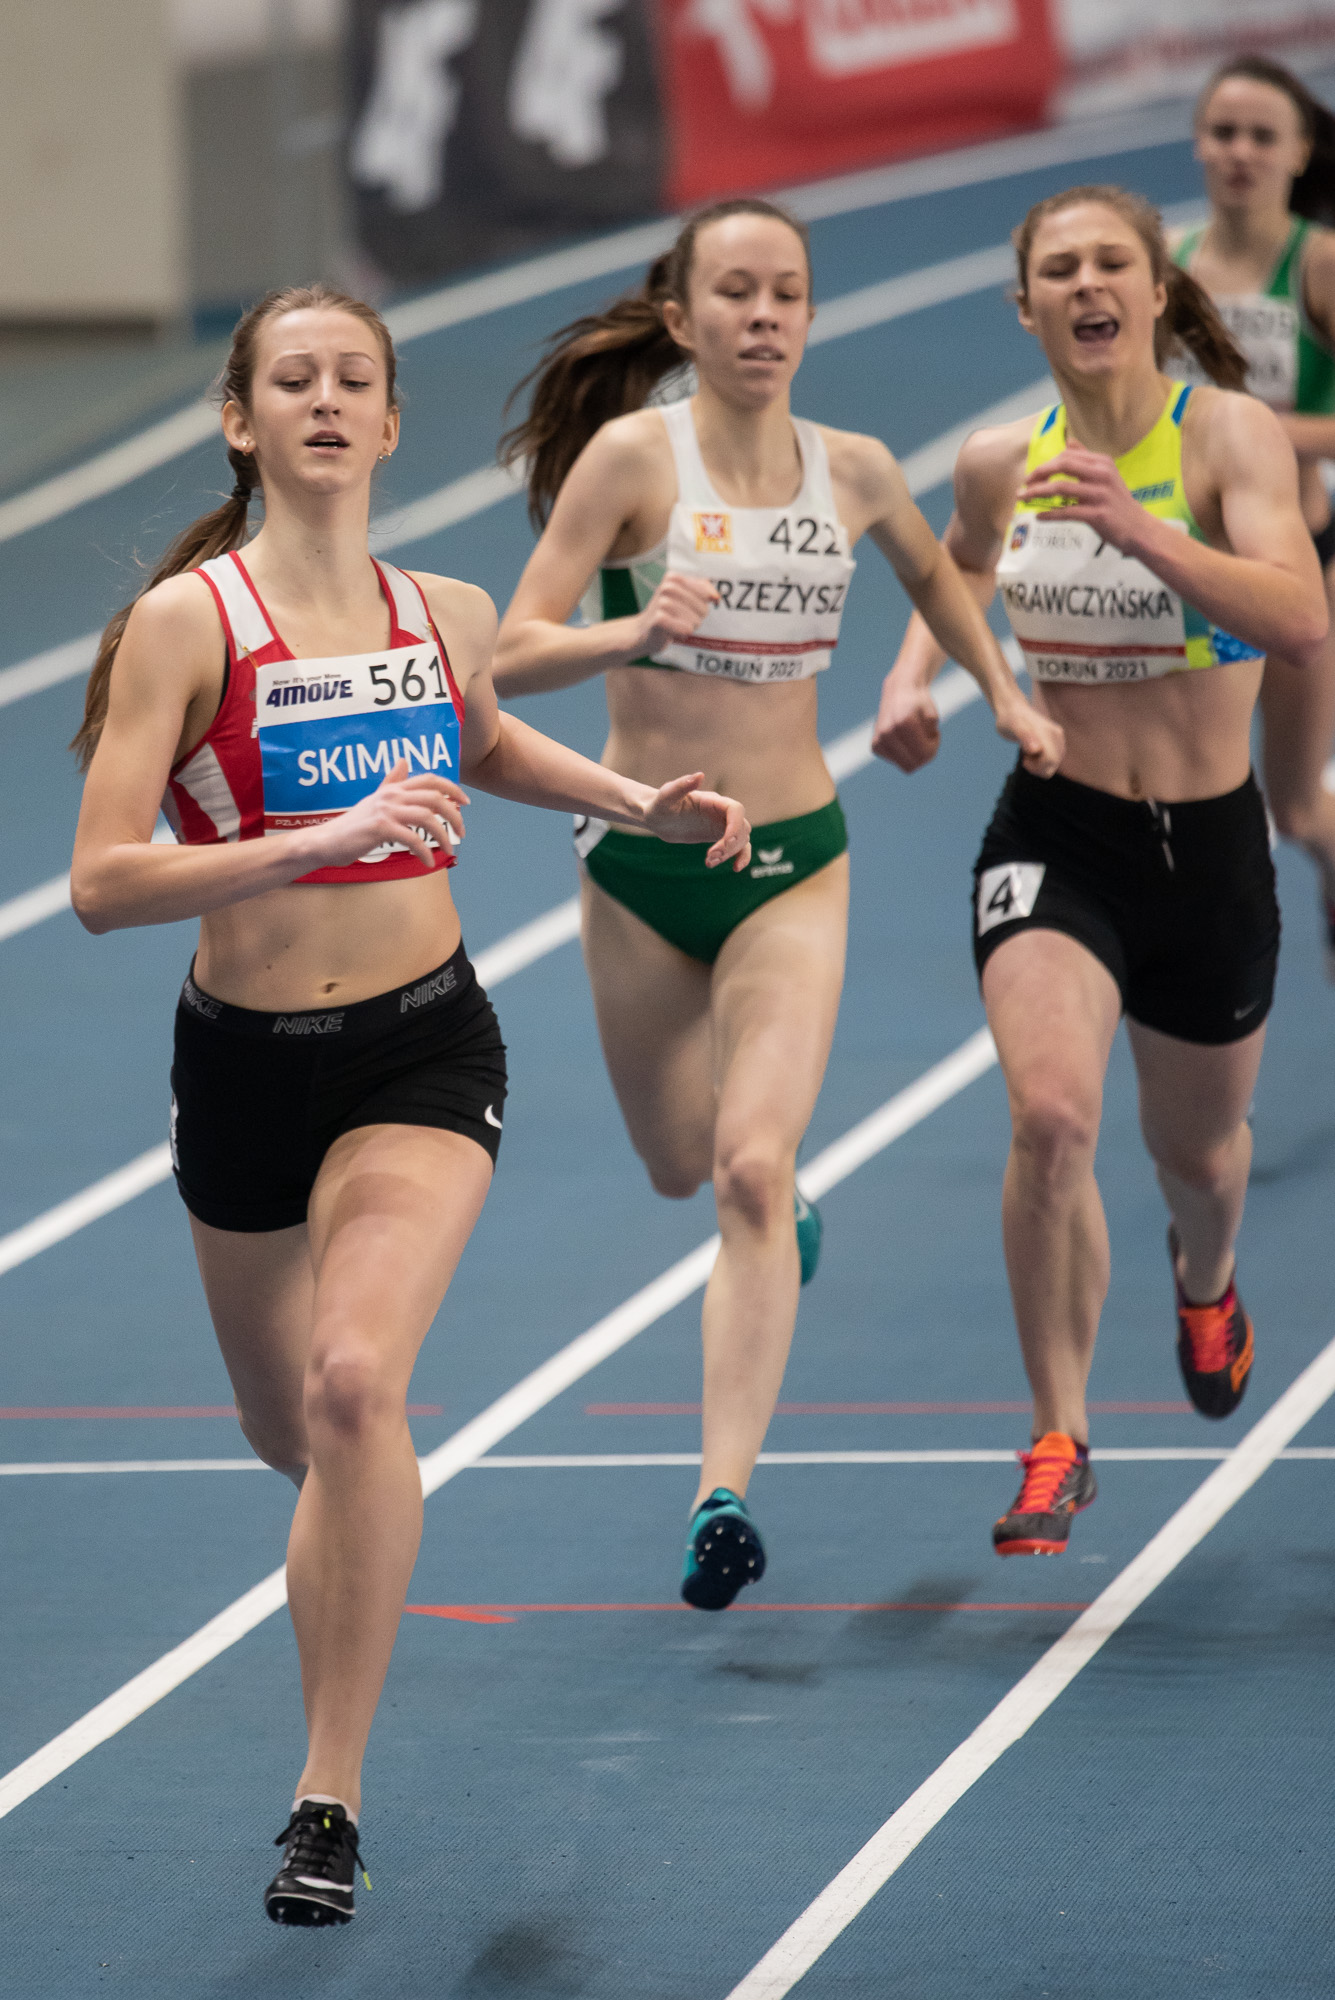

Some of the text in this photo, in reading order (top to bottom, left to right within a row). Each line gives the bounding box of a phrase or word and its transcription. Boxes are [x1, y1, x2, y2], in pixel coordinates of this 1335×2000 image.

[711, 576, 845, 615] RZEŻYSZ
[368, 655, 447, 706] 561
[1104, 660, 1149, 679] 2021
[297, 733, 452, 786] SKIMINA
[986, 874, 1014, 916] 4
[400, 965, 457, 1013] NIKE
[272, 1012, 345, 1036] NIKE
